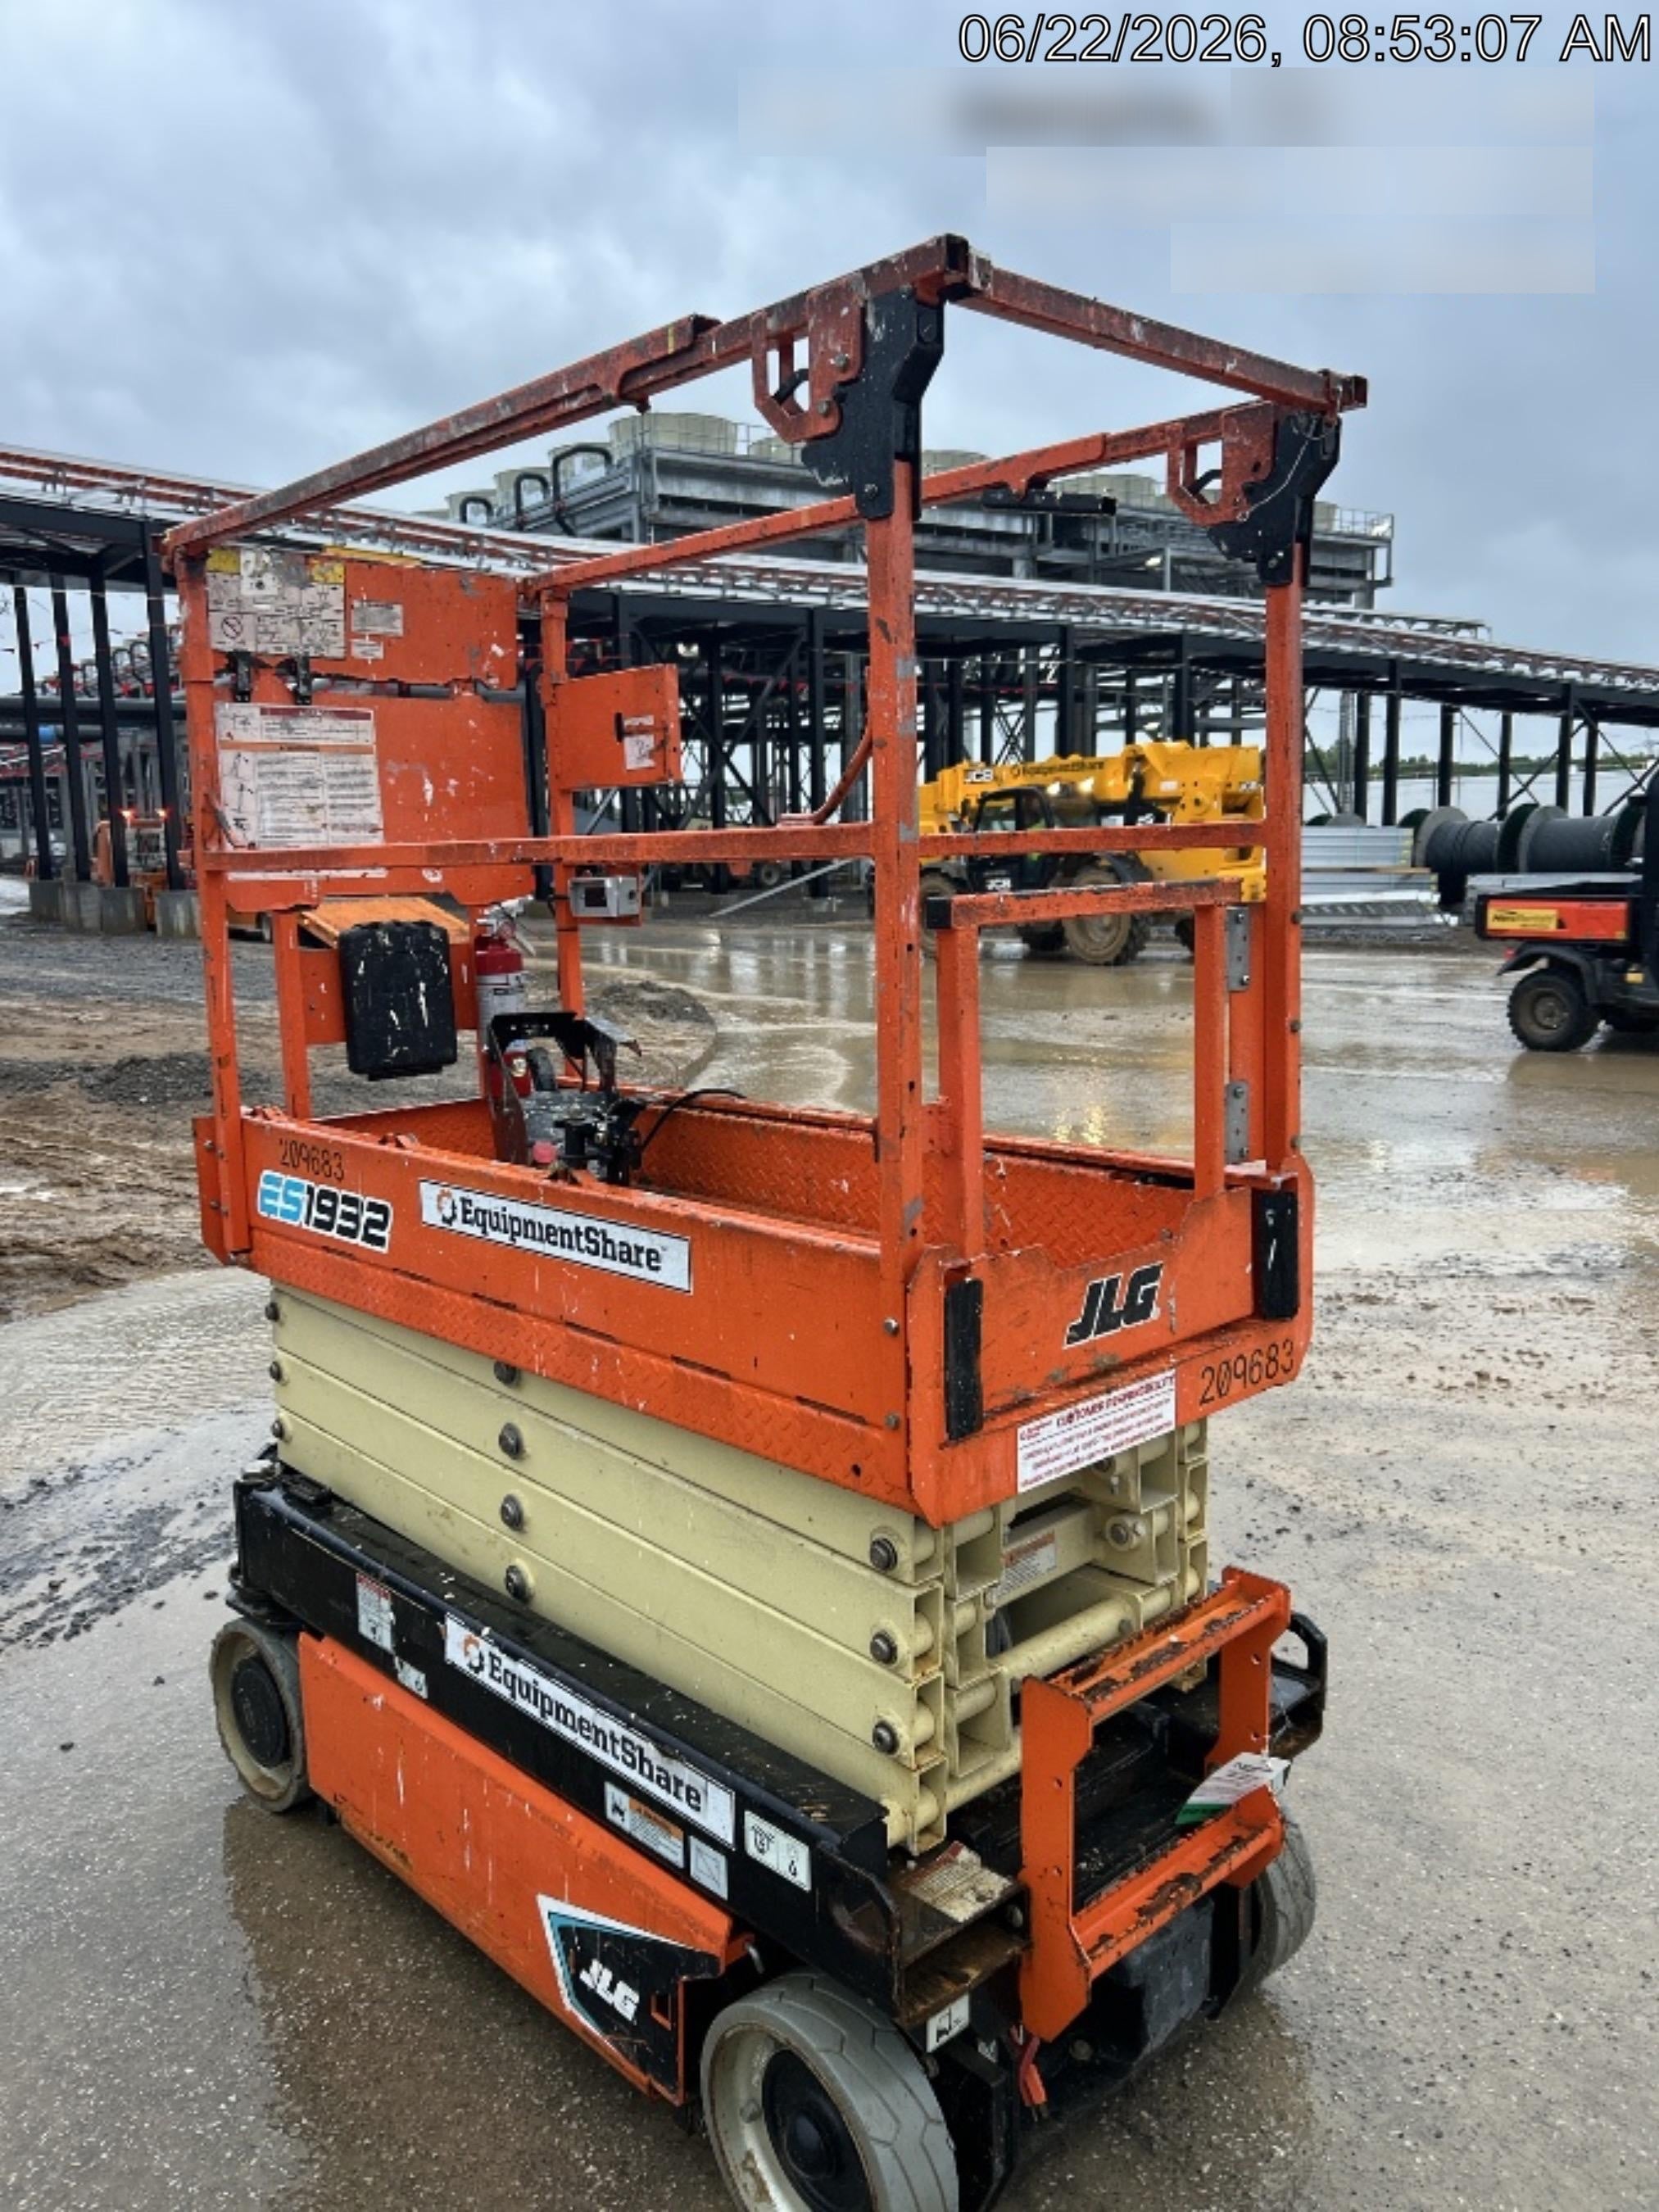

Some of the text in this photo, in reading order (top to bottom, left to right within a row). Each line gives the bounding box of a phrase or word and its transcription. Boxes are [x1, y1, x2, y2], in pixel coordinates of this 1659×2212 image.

[279, 1137, 345, 1182] 209683
[258, 1170, 392, 1253] ES1932
[460, 1191, 662, 1273] EquipmentShare
[1064, 1261, 1164, 1350] JLG
[1199, 1338, 1294, 1407] 209683
[488, 1648, 703, 1813] EquipmentShare
[579, 1958, 641, 2022] JLG
